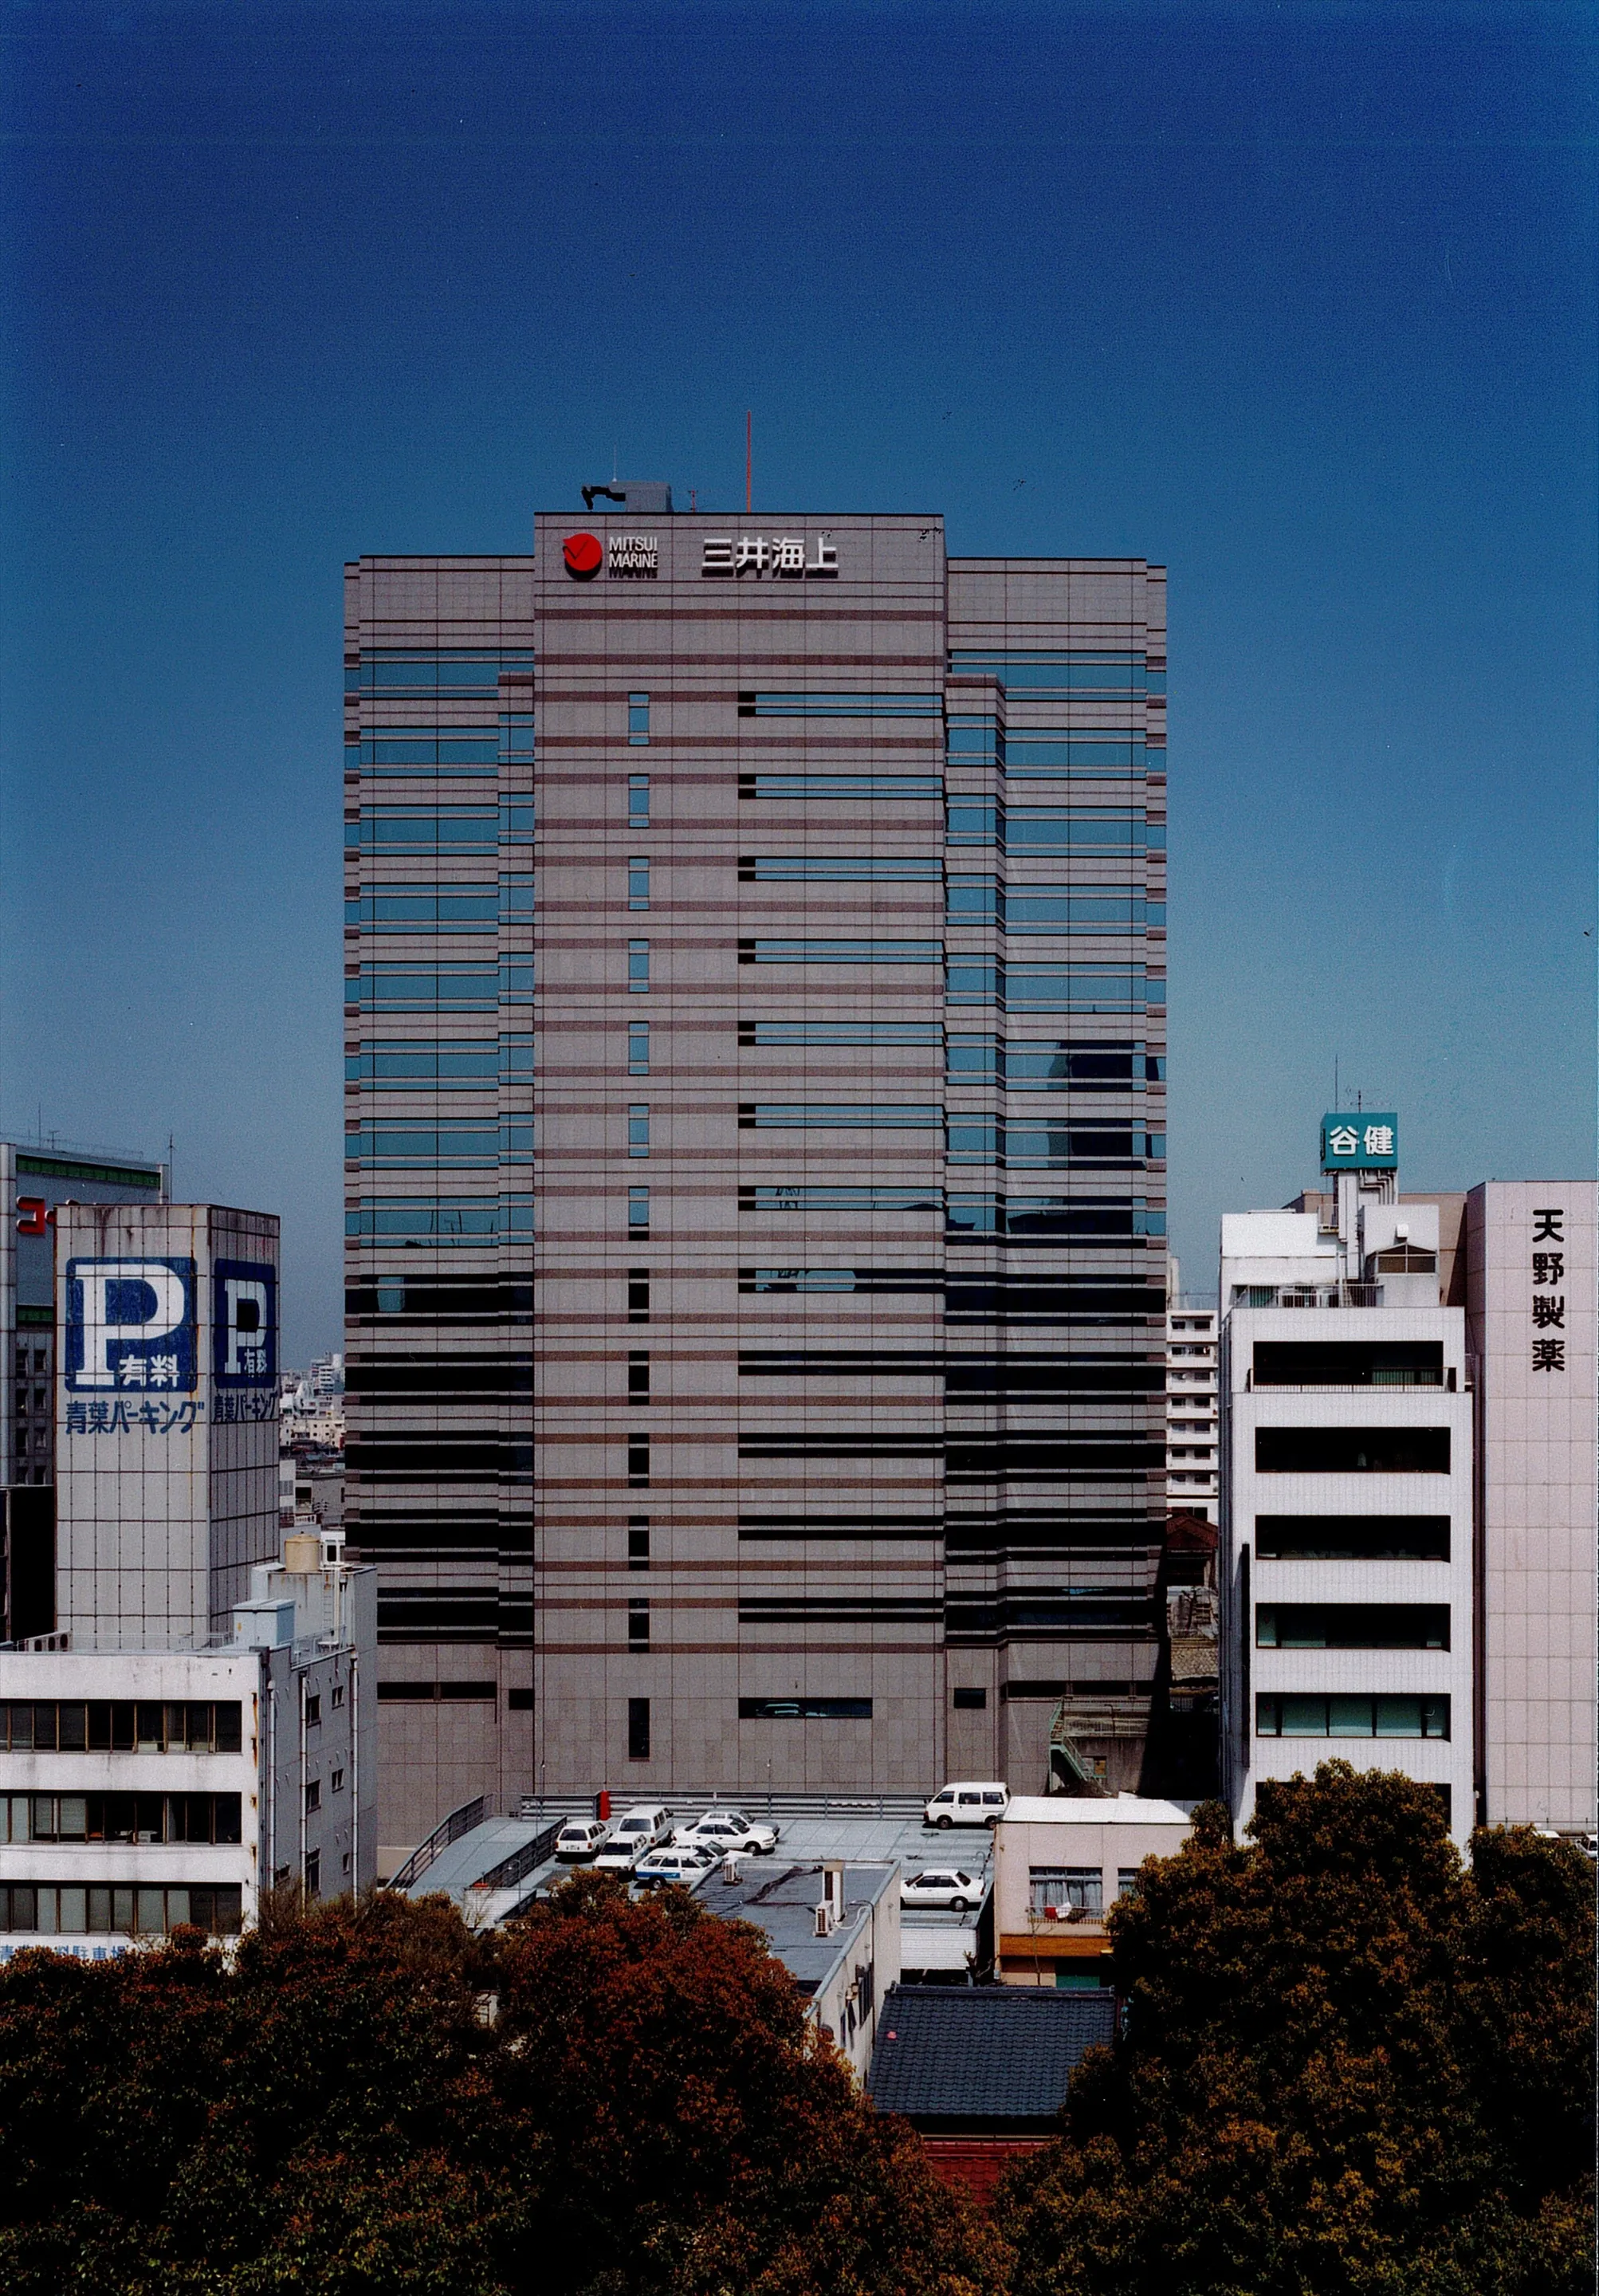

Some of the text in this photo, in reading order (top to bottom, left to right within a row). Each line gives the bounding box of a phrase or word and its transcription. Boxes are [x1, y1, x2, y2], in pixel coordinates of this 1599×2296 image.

[609, 537, 658, 552] MITSUI
[609, 553, 658, 568] MARINE
[701, 537, 839, 568] 三井海上
[1329, 1125, 1394, 1155] 谷健
[1531, 1209, 1566, 1373] 天野製薬
[75, 1264, 185, 1386] P
[224, 1279, 267, 1374] P
[120, 1354, 180, 1387] 有料
[65, 1400, 205, 1434] 青葉パーキング
[214, 1390, 278, 1423] 青葉パーキング
